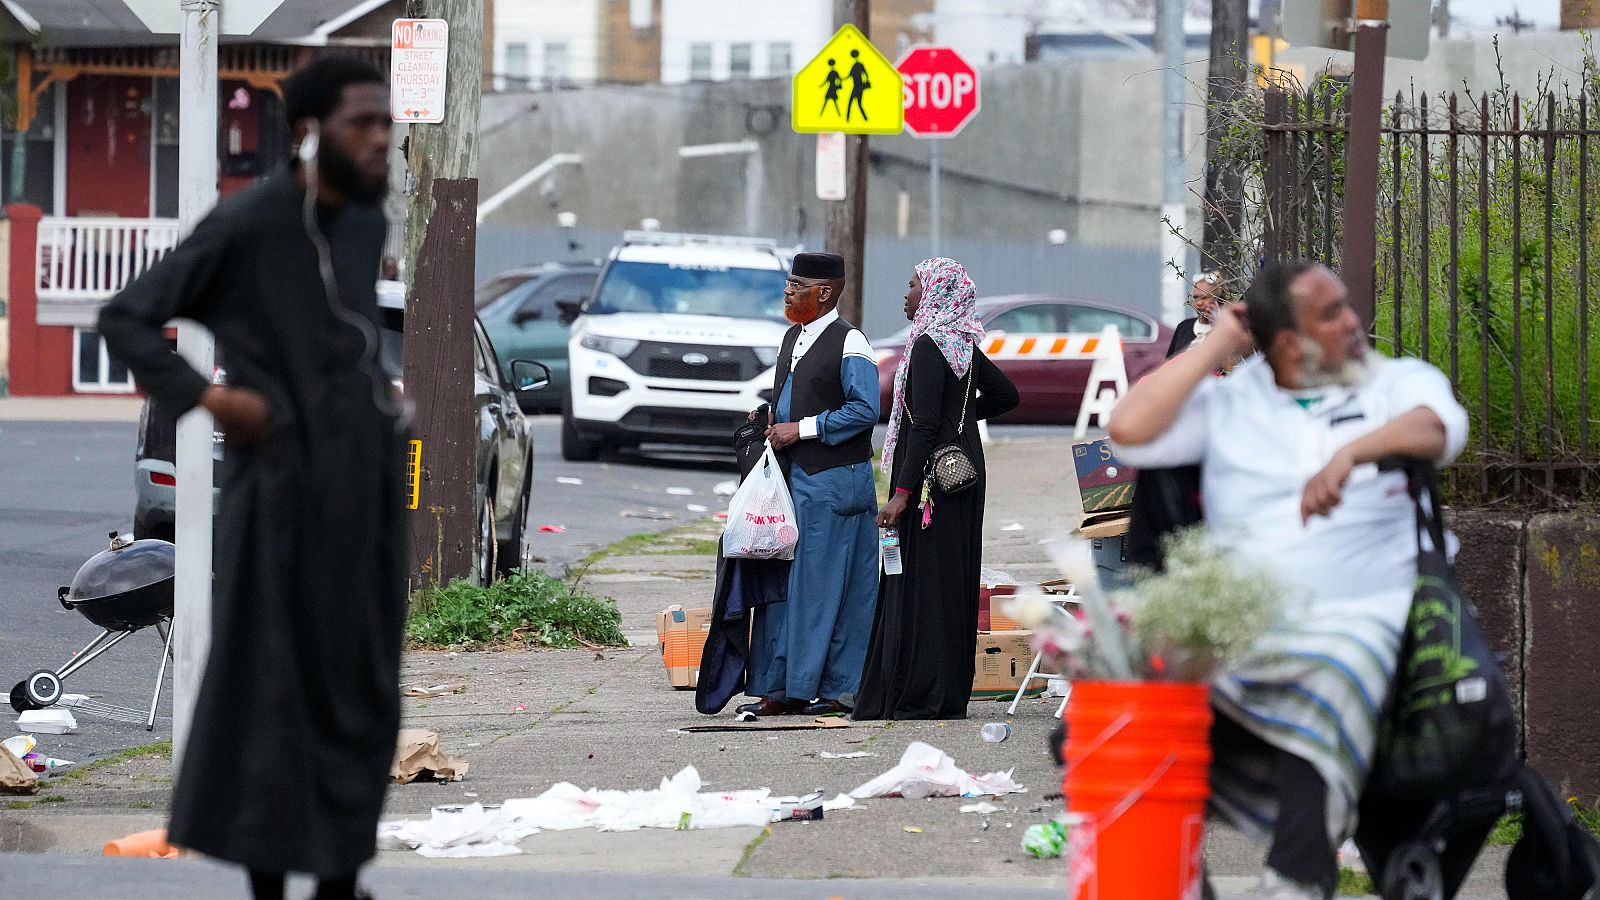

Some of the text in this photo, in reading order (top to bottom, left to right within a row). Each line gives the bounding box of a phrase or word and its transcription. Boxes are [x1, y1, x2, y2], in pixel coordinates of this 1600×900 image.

[395, 25, 443, 44] NO PARKING
[404, 51, 433, 60] STREET
[398, 62, 439, 72] CLEANING
[395, 73, 440, 85] THURSDAY
[903, 72, 973, 109] STOP
[766, 513, 786, 523] YOU
